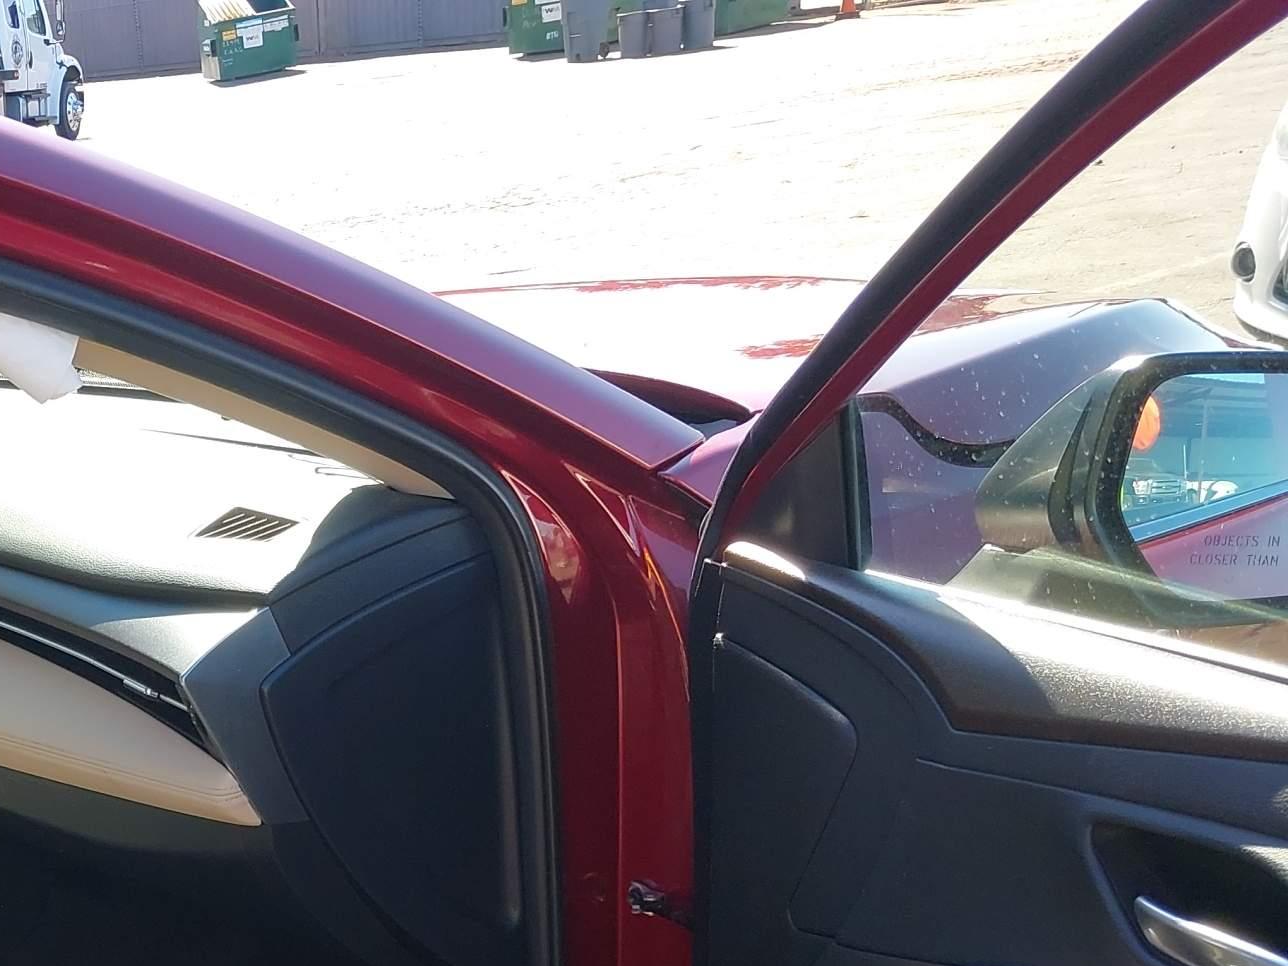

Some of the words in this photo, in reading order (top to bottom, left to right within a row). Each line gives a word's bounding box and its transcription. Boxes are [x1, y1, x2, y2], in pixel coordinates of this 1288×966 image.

[1204, 535, 1259, 547] OBJECTS
[1267, 535, 1280, 547] IN
[1190, 554, 1237, 566] CLOSER
[1247, 554, 1279, 566] THAN
